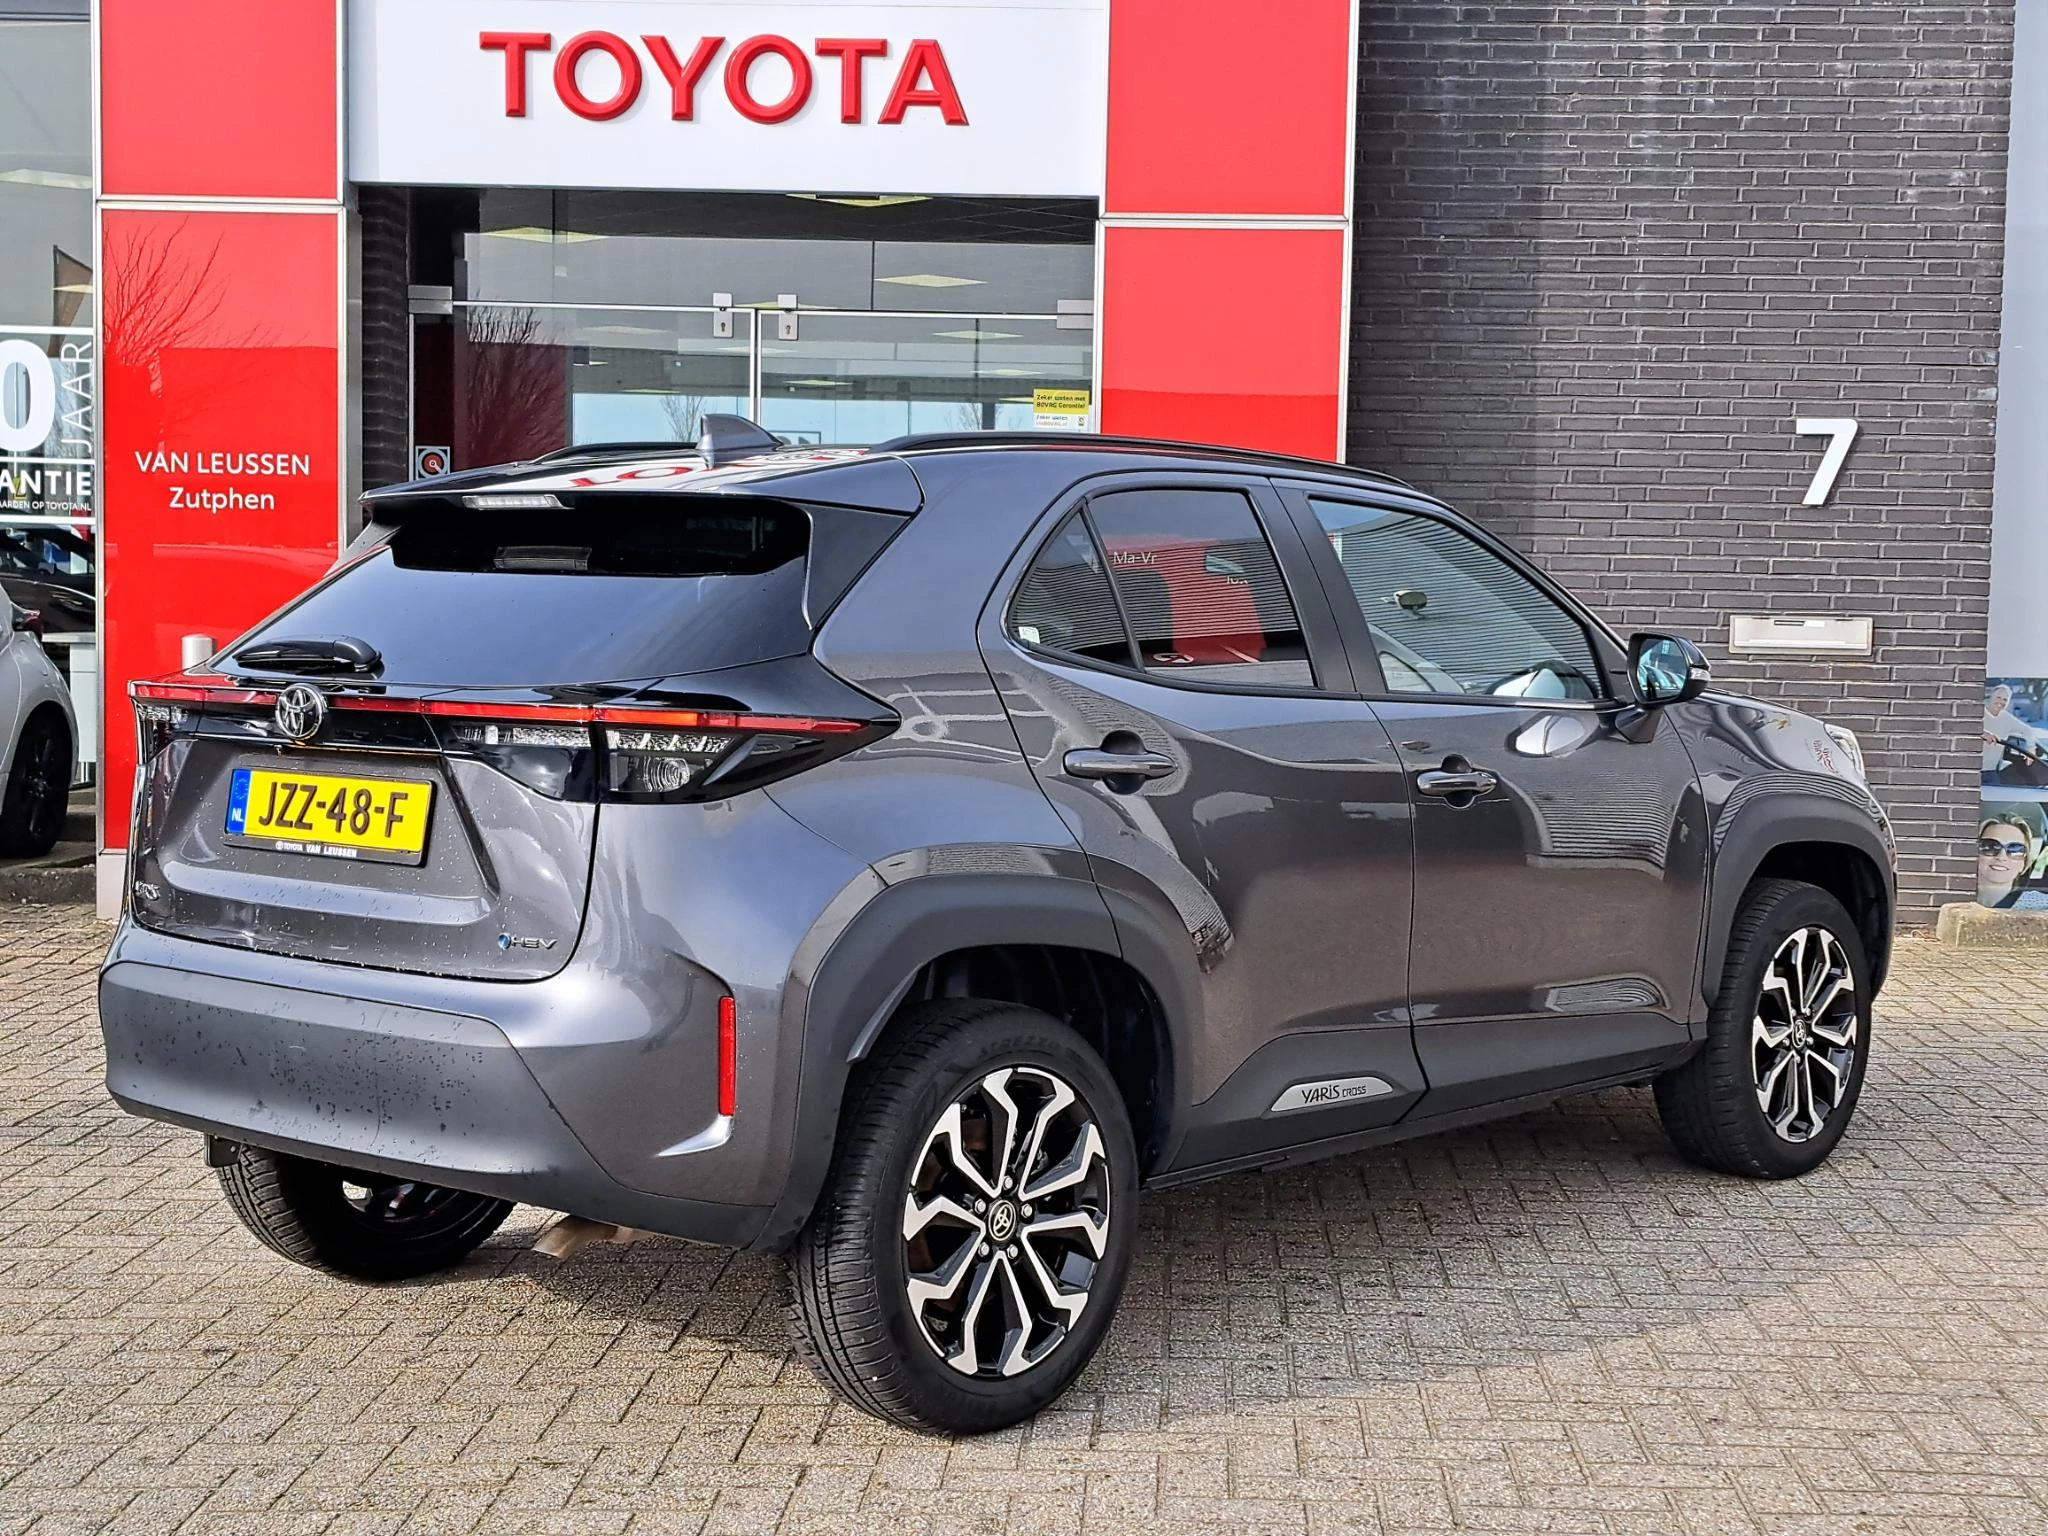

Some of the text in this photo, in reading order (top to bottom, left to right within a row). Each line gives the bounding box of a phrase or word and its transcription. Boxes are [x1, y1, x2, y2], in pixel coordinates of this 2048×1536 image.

[479, 30, 970, 126] TOYOTA
[61, 341, 92, 453] JAAR
[134, 451, 310, 476] VAN LEUSSEN
[1796, 418, 1858, 505] 7
[31, 500, 45, 511] OP
[168, 486, 275, 514] Zutphen
[1112, 551, 1157, 564] Ma-Vr
[231, 807, 245, 822] NL
[258, 781, 409, 838] JZZ-48-F
[306, 844, 321, 855] VAN
[323, 845, 357, 858] LEUSSEN
[1301, 1084, 1367, 1104] YARIS CROSS
